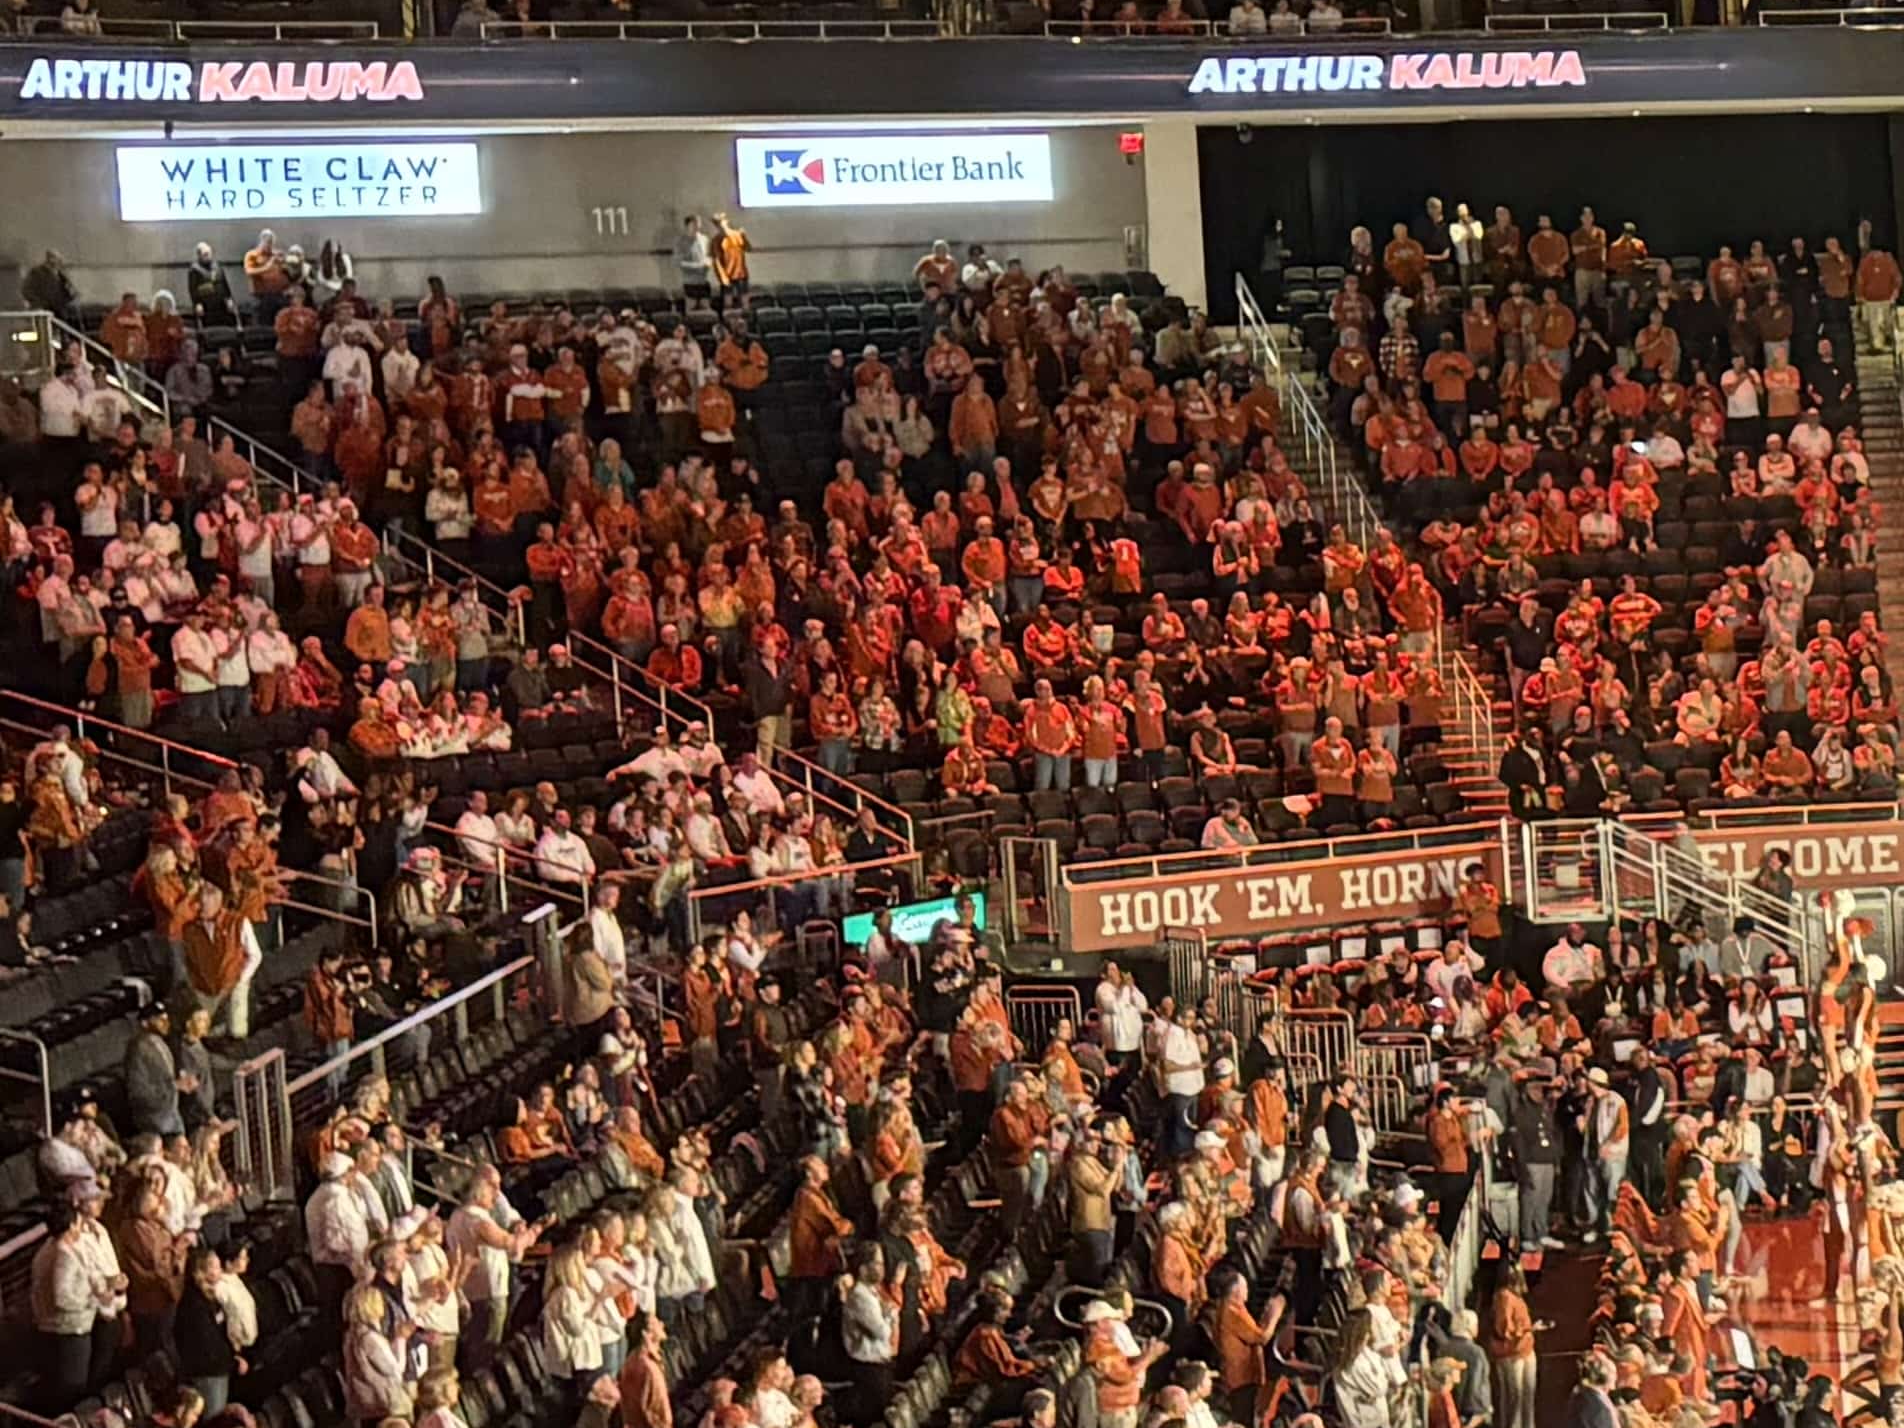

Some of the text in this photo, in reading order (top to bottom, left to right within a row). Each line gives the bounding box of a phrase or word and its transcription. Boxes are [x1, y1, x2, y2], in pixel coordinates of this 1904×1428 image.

[19, 57, 425, 103] ARTHUR KALUMA
[1188, 49, 1587, 94] ARTHUR KALUMA
[161, 154, 438, 184] WHITE CLAW
[833, 150, 1025, 186] Frontier Bank
[166, 184, 438, 210] HARD SELTZER
[591, 206, 630, 235] 111
[1100, 892, 1217, 937] HOOK
[1235, 880, 1325, 923] 'EM,
